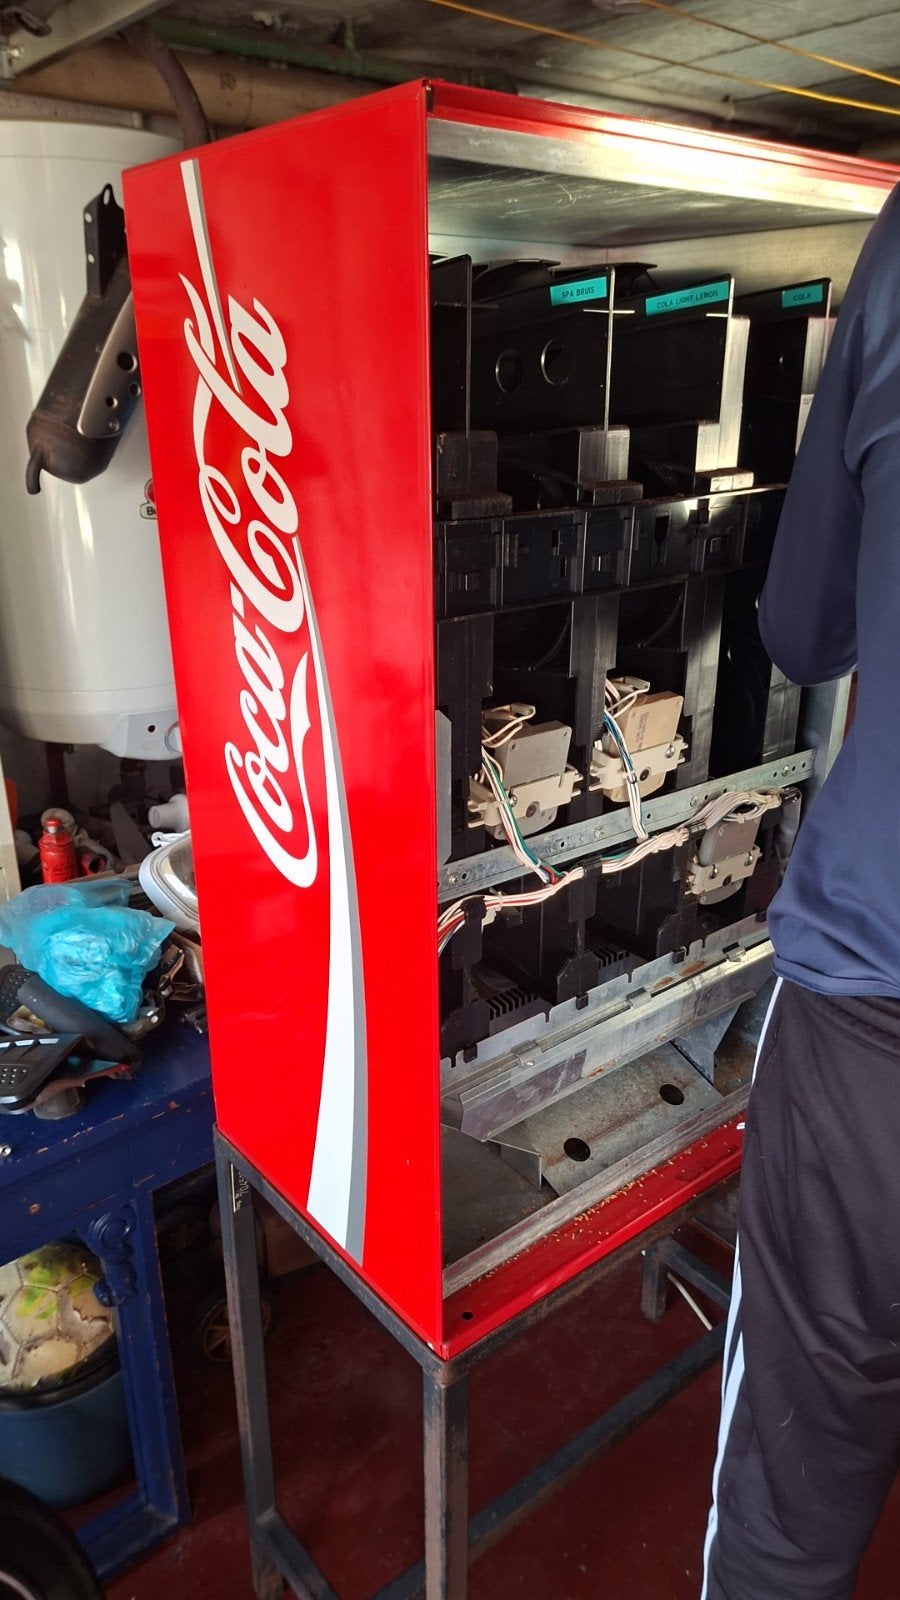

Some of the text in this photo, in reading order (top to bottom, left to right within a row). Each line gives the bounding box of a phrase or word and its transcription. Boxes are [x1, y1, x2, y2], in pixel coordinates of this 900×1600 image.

[561, 286, 595, 299] SPA BRUIS
[793, 292, 812, 302] COLA
[656, 290, 718, 309] COLA LIGHT LEMON
